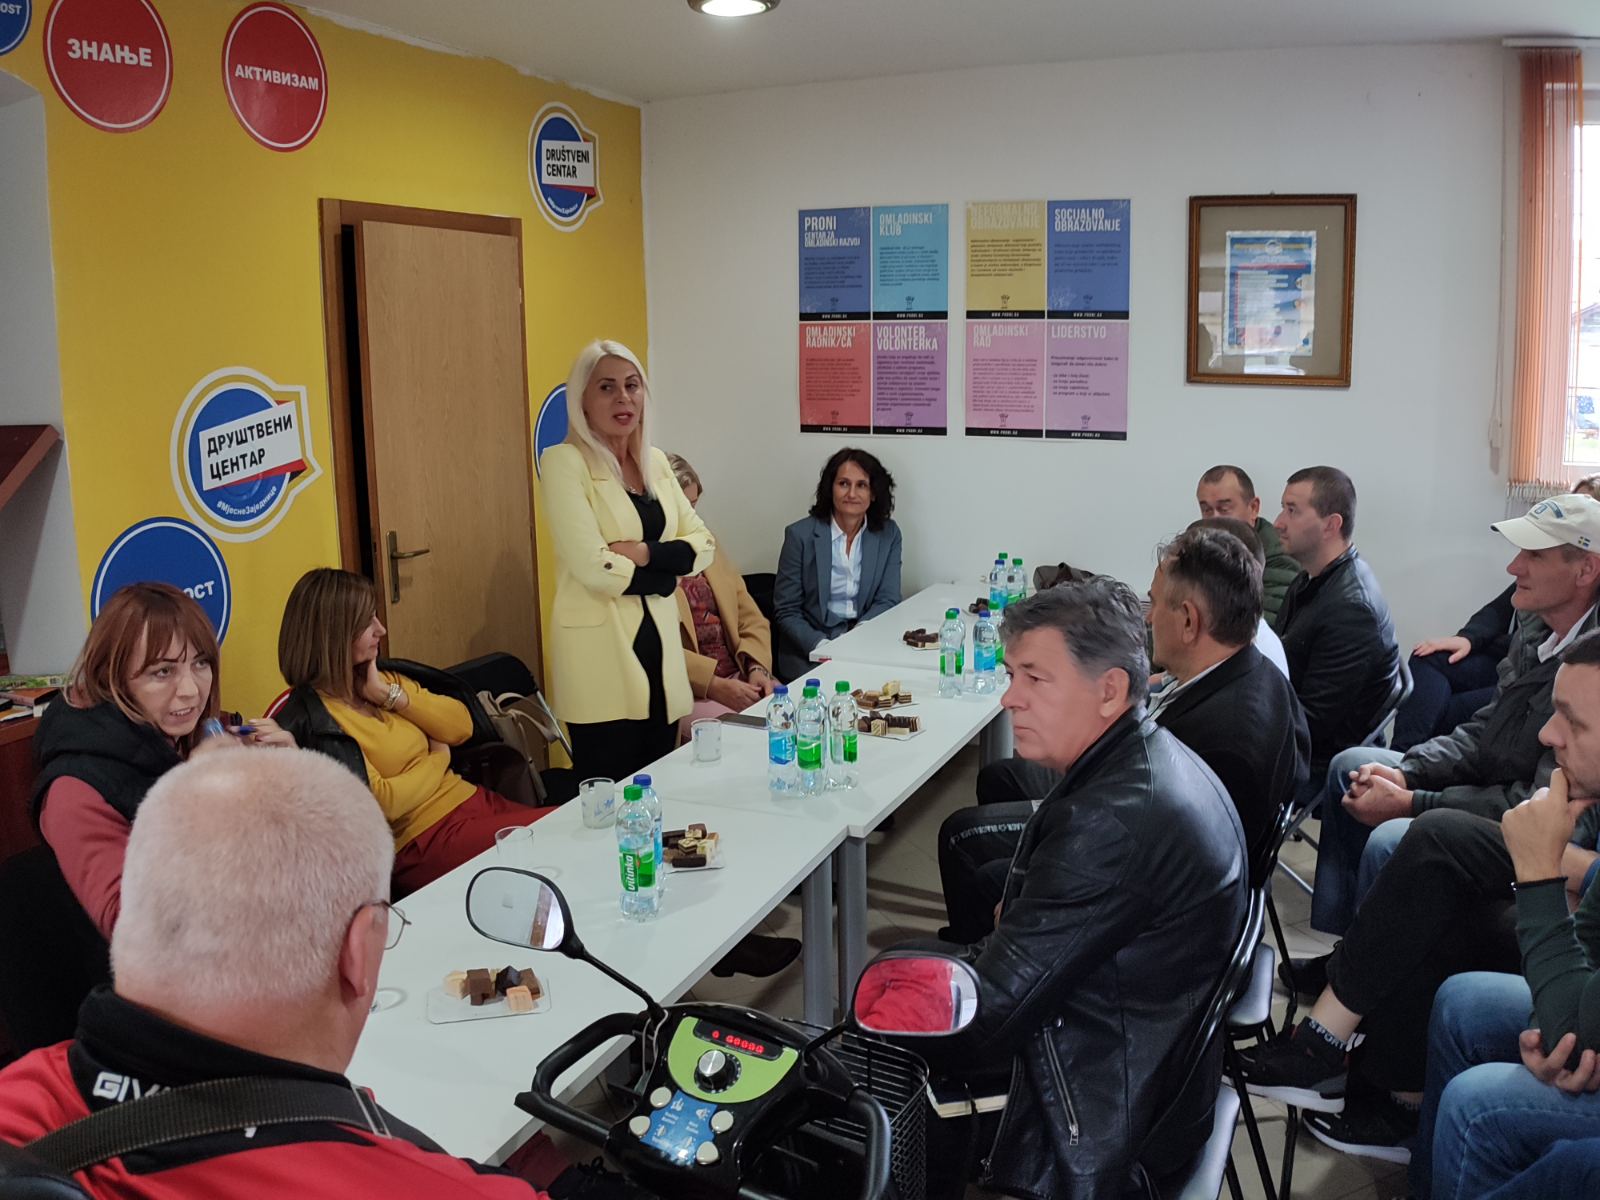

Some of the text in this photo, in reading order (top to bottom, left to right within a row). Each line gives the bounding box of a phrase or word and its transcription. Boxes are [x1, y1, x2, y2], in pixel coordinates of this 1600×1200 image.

[67, 38, 153, 67] ЗНАЊЕ
[235, 64, 319, 91] АКТИВИЗАМ
[545, 145, 590, 163] DRUŠTVENI
[546, 163, 578, 179] CENTAR
[880, 212, 933, 226] OMLADINSKI
[1054, 207, 1105, 220] SOCIJALNO
[804, 216, 837, 231] PRONI
[880, 224, 902, 237] KLUB
[1054, 218, 1121, 232] OBRAZOVANJE
[805, 325, 856, 338] OMLADINSKI
[876, 325, 926, 339] VOLONTER
[973, 323, 1029, 337] OMLADINSKI
[1051, 325, 1107, 339] LIDERSTVO
[876, 336, 938, 351] VOLONTERKA
[973, 335, 992, 348] RAD
[207, 414, 293, 457] ДРУШТВЕНИ
[209, 448, 266, 481] ЦЕНТАР
[625, 855, 636, 891] vitinka
[1309, 1019, 1346, 1050] SPORT
